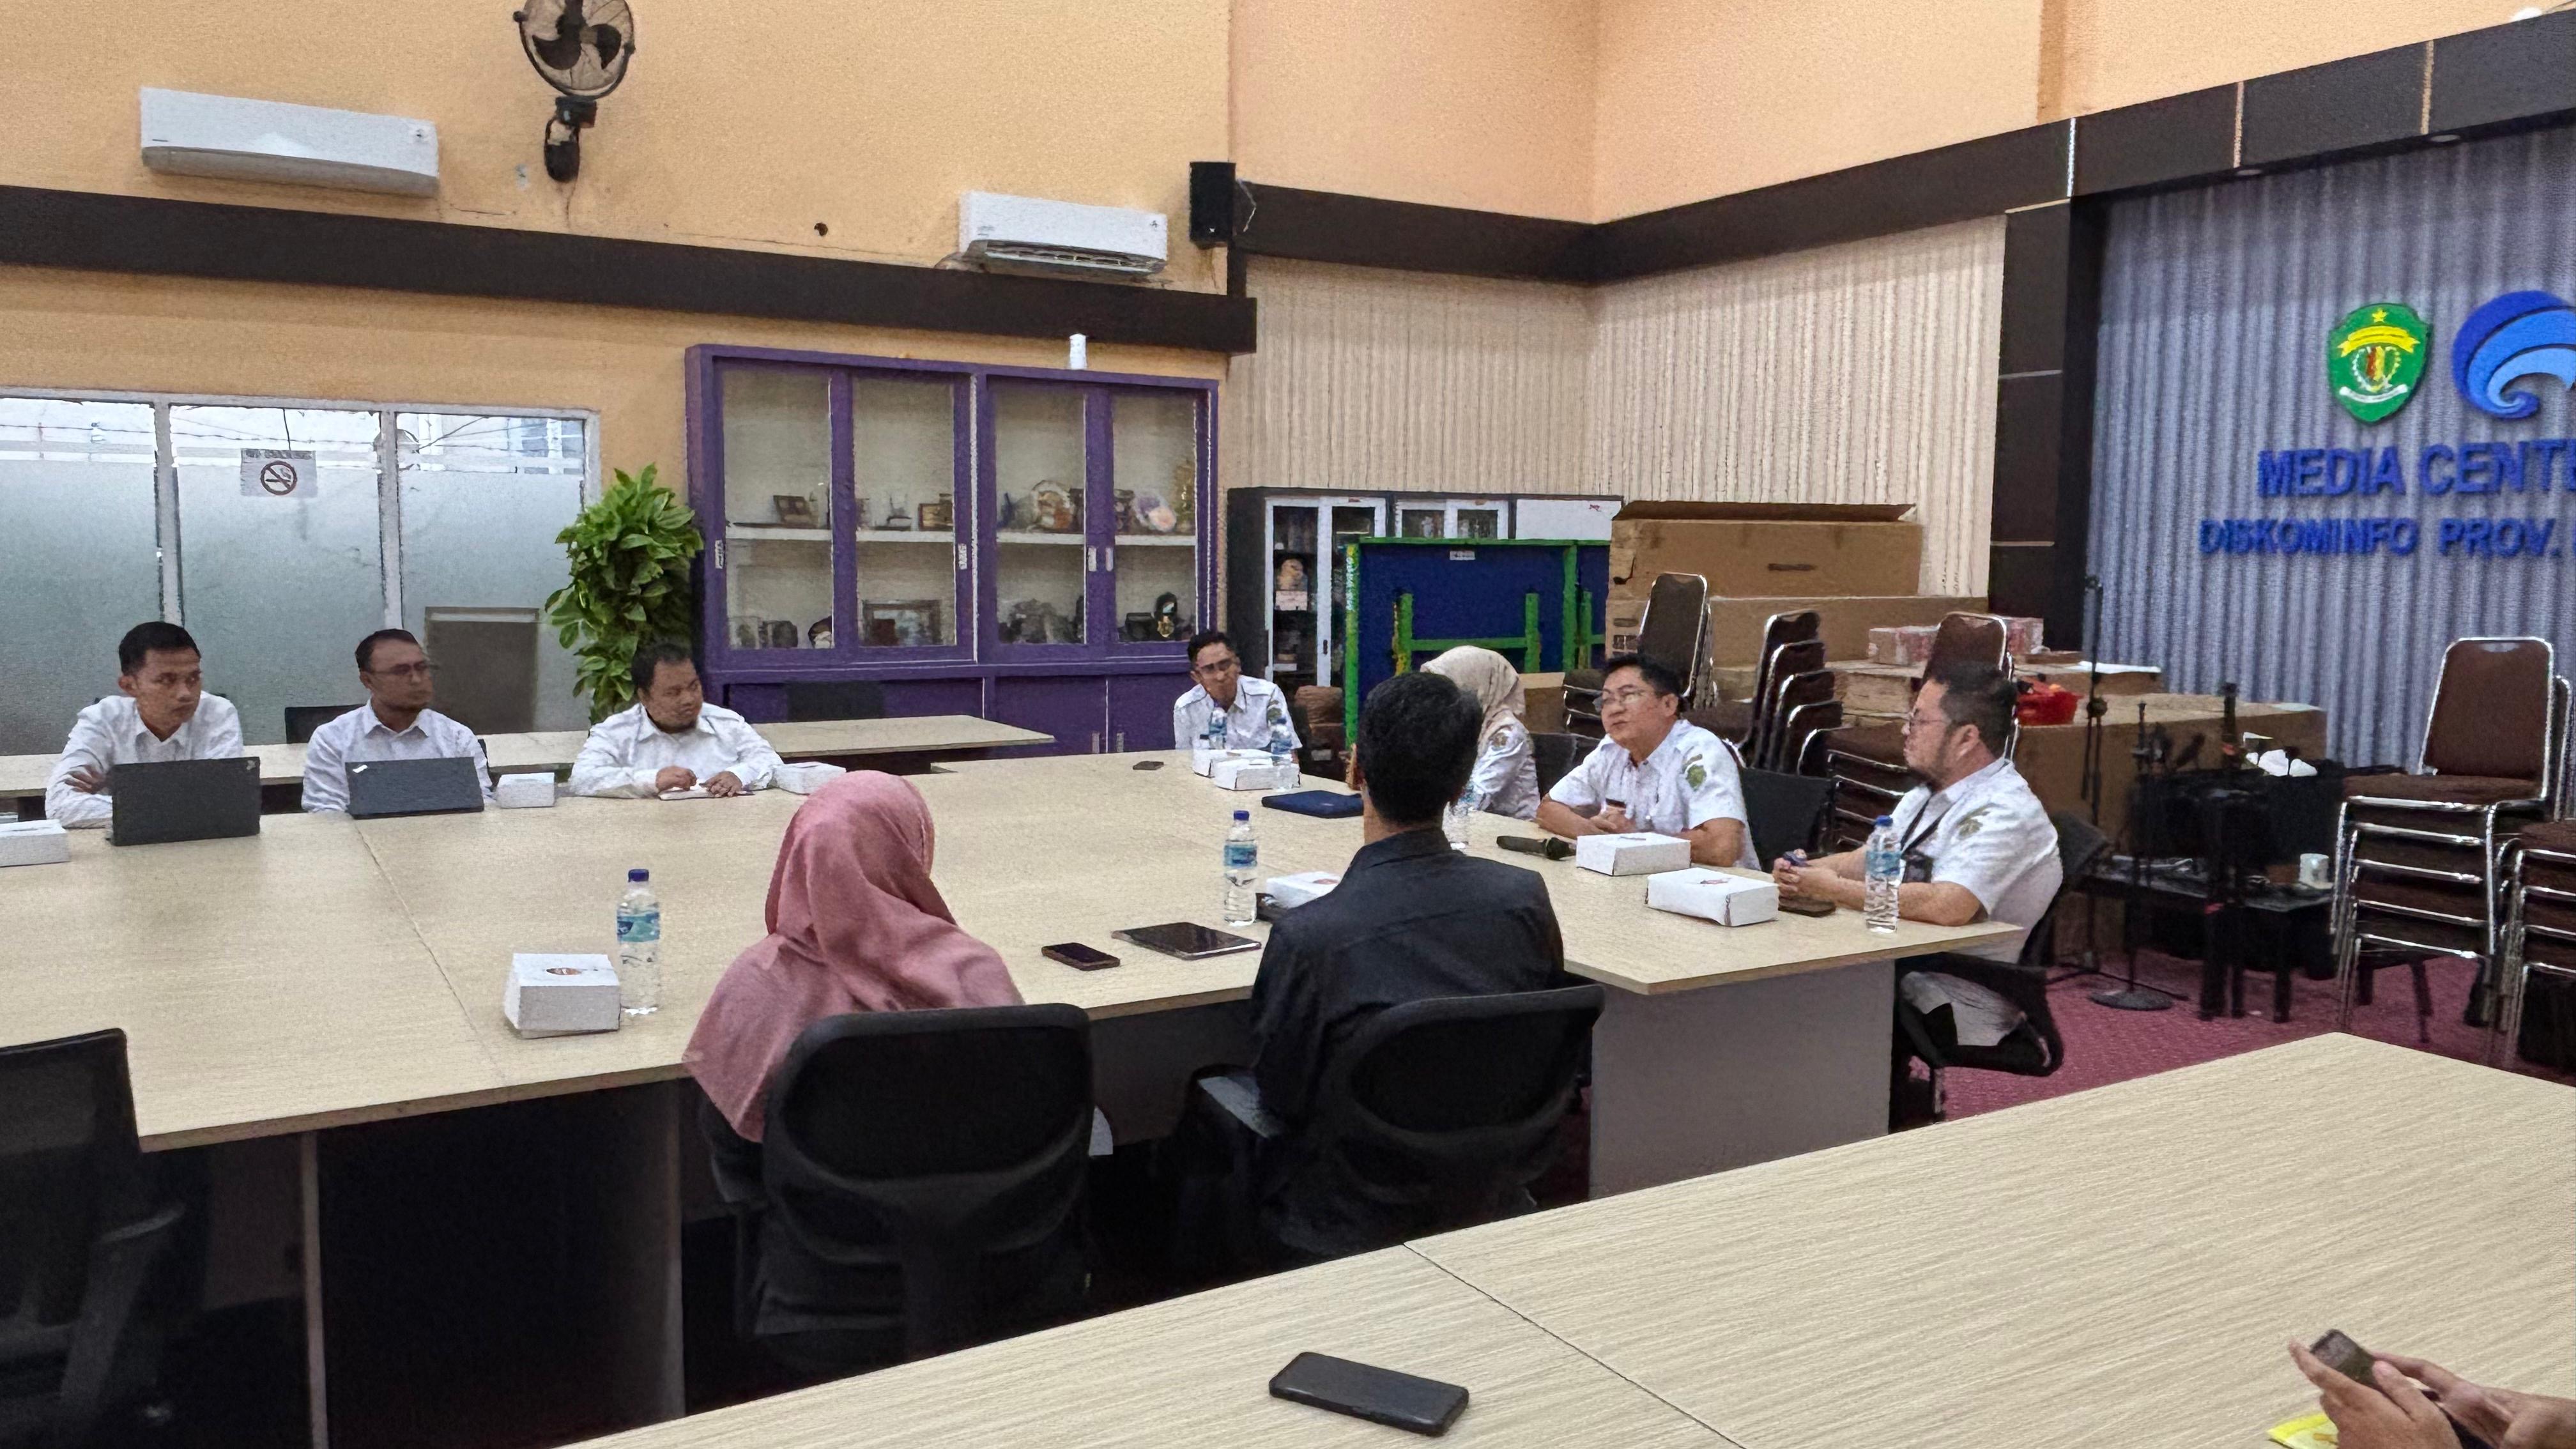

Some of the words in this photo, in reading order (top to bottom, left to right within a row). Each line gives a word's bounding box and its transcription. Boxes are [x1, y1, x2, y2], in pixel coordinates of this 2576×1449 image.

[2258, 449, 2405, 496] MEDIA
[2199, 519, 2418, 554] DISKOMINFO
[2440, 518, 2560, 557] PROV.
